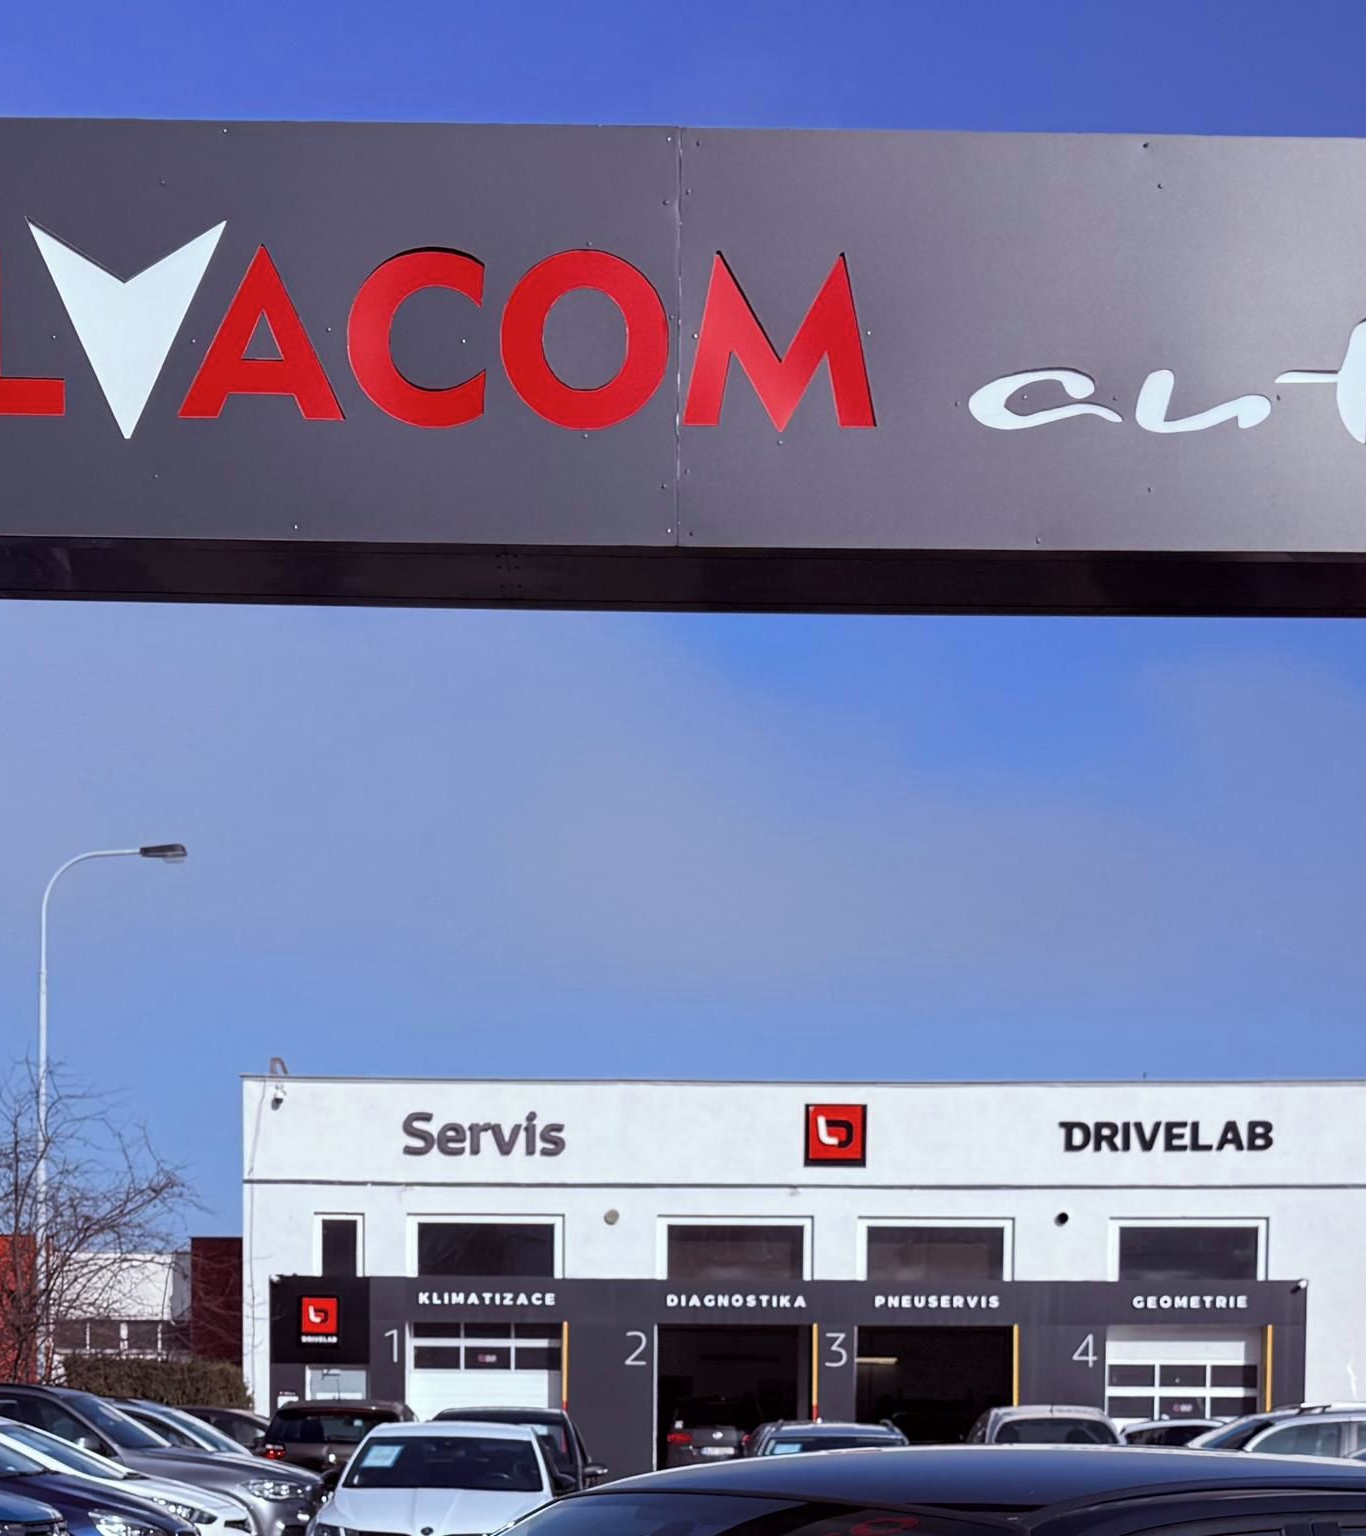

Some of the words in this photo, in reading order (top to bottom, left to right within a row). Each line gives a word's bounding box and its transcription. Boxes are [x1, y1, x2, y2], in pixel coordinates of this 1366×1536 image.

[402, 1111, 566, 1157] Servis
[1058, 1120, 1274, 1152] DRIVELAB
[418, 1291, 557, 1308] KLIMATIZACE
[665, 1293, 808, 1309] DIAGNOSTIKA
[874, 1294, 1001, 1309] PNEUSERVIS
[1132, 1295, 1249, 1310] GEOMETRIE
[383, 1328, 399, 1363] 1
[624, 1330, 648, 1367] 2
[824, 1331, 849, 1368] 3
[1071, 1332, 1098, 1369] 4
